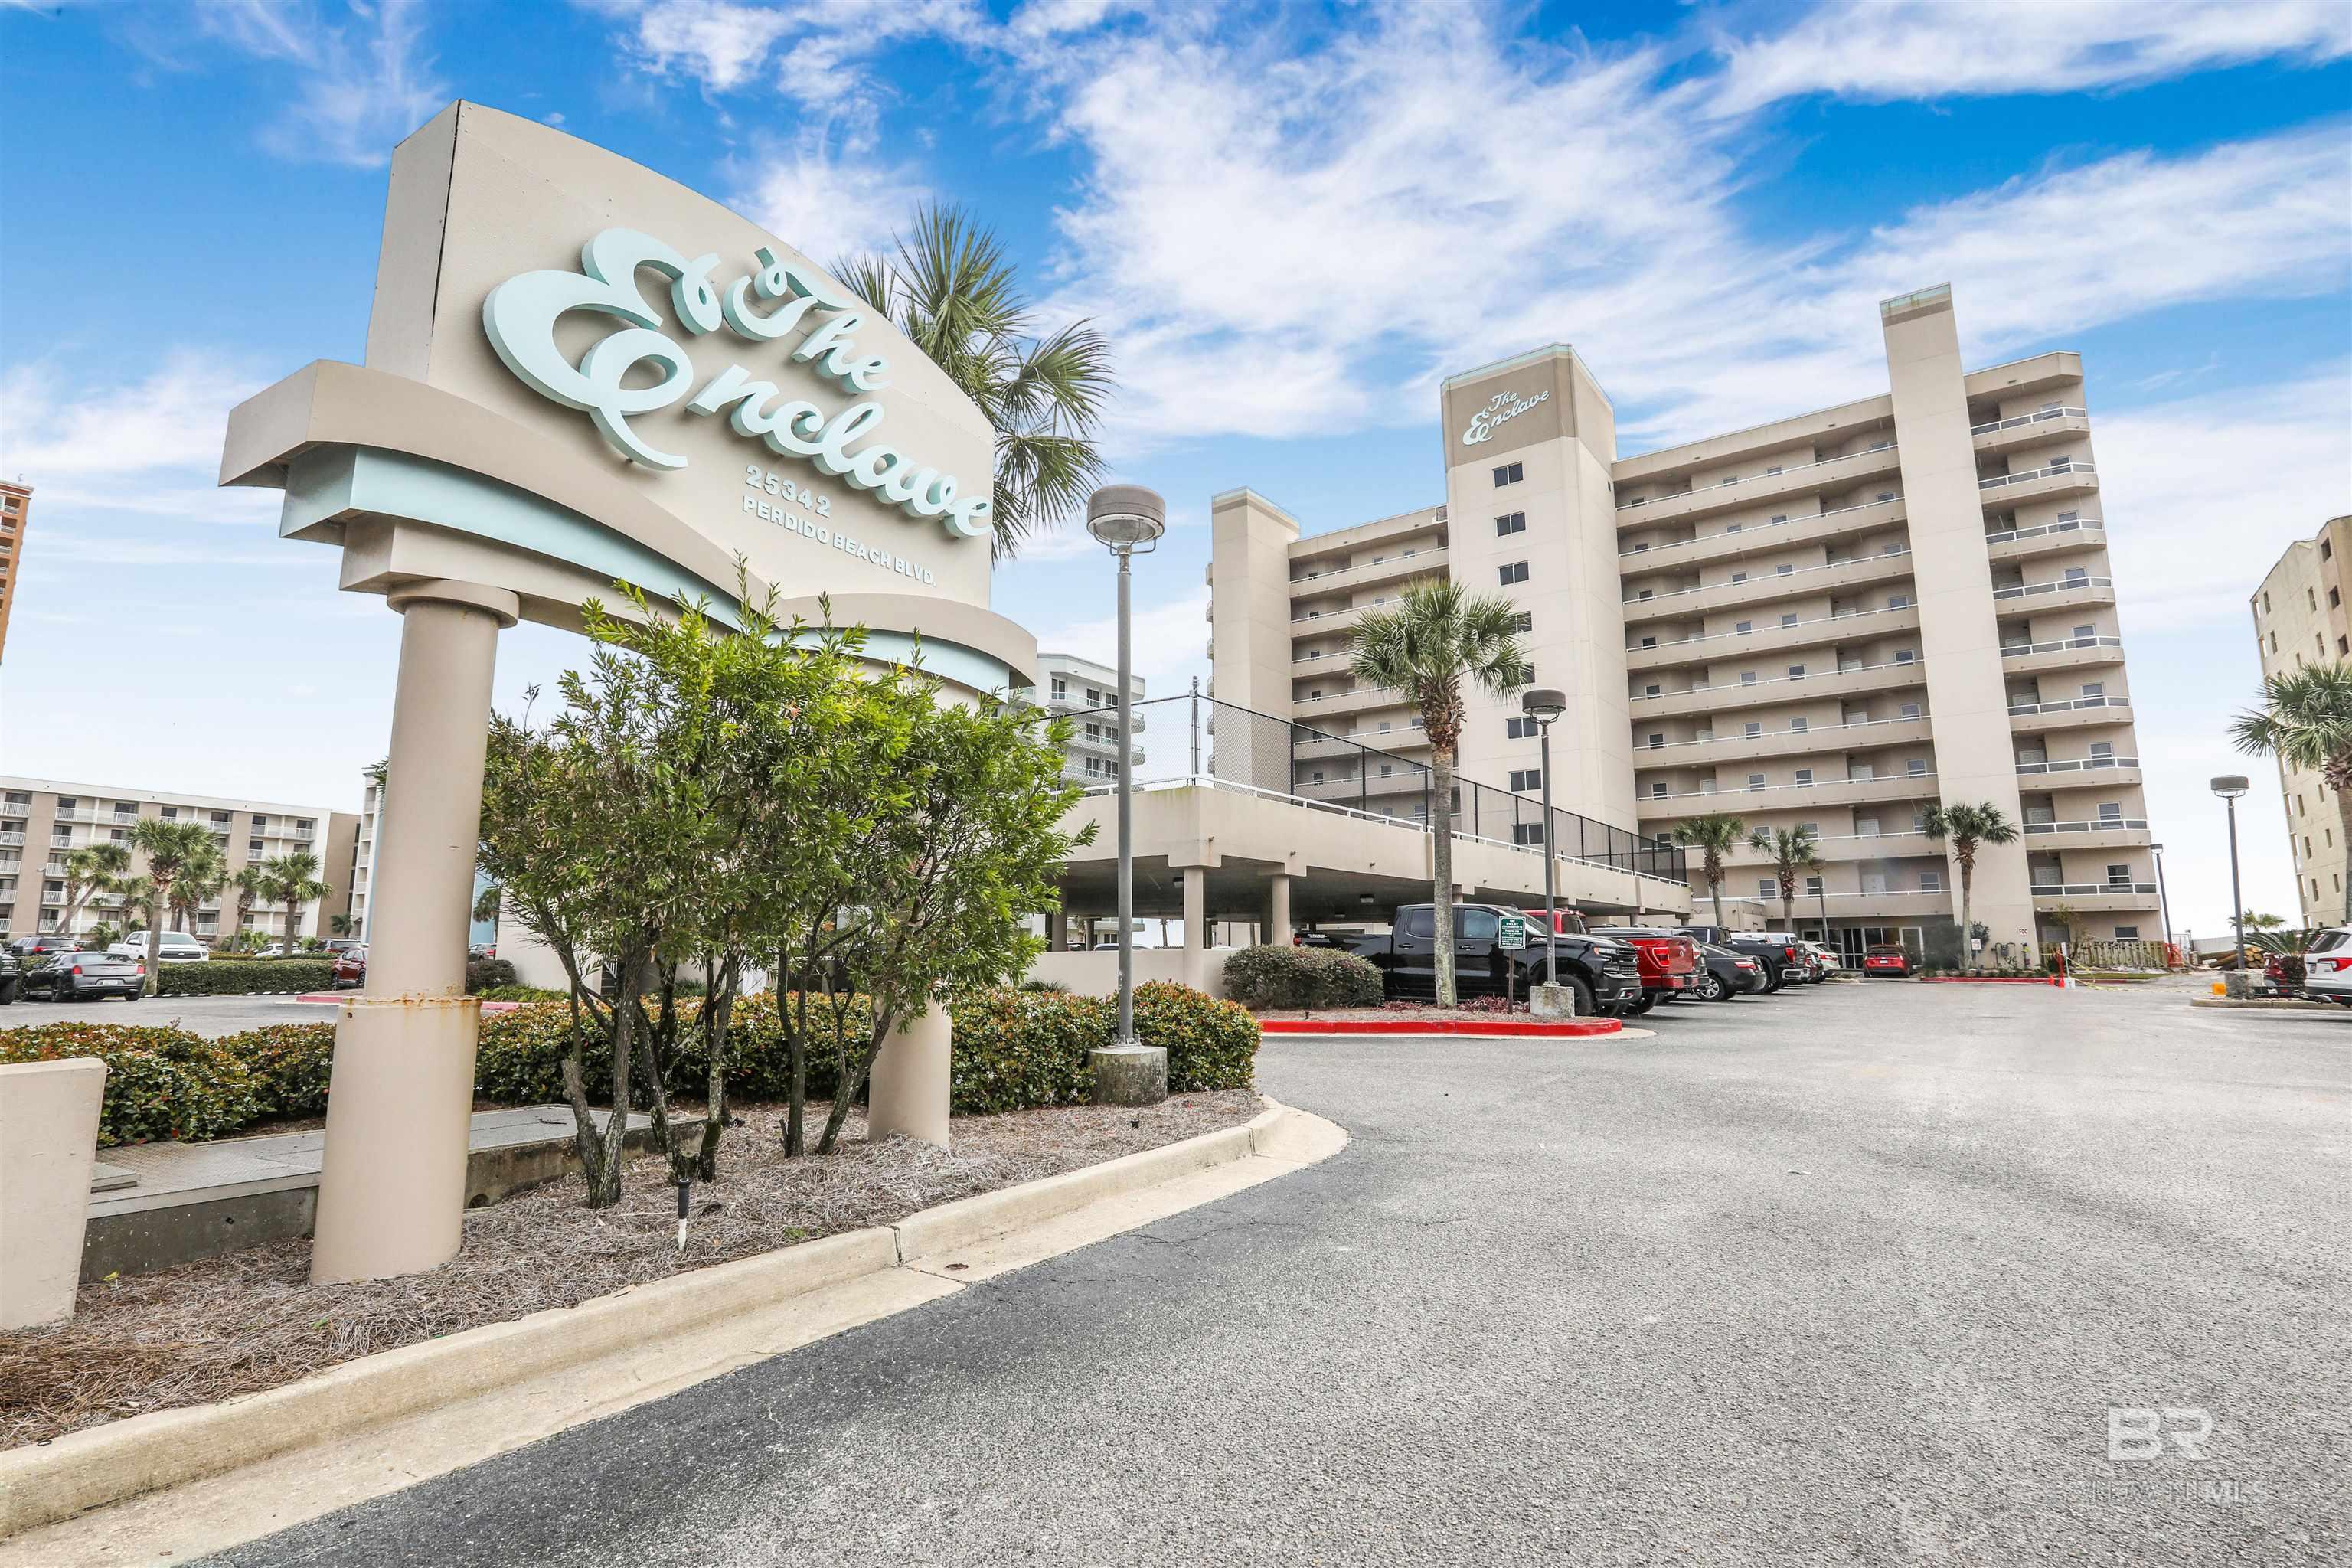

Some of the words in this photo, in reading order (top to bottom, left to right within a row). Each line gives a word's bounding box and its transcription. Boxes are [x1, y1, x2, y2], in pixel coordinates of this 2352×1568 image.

[723, 245, 893, 395] The
[482, 227, 995, 539] Enclave
[1462, 390, 1550, 446] Enclave
[1488, 391, 1519, 412] The
[746, 465, 831, 518] 25342
[743, 495, 829, 544] PERDIDO
[833, 532, 891, 569] BEACH
[894, 557, 936, 587] BLVD.
